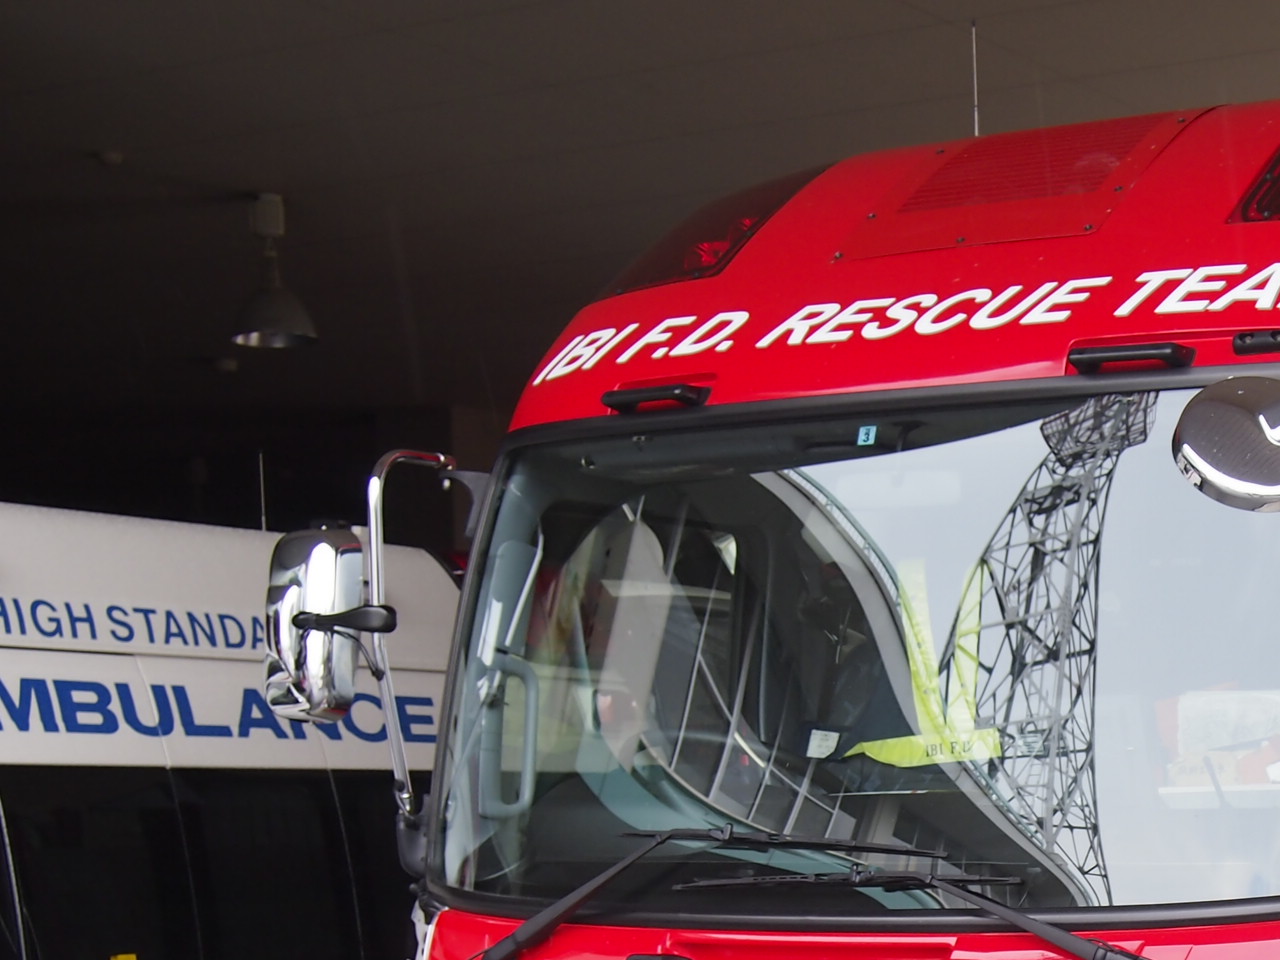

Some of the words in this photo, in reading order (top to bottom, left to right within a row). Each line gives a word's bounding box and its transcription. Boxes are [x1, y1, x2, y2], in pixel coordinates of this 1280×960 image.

[532, 323, 640, 386] IBI
[615, 310, 751, 364] F.D.
[756, 276, 1112, 349] RESCUE
